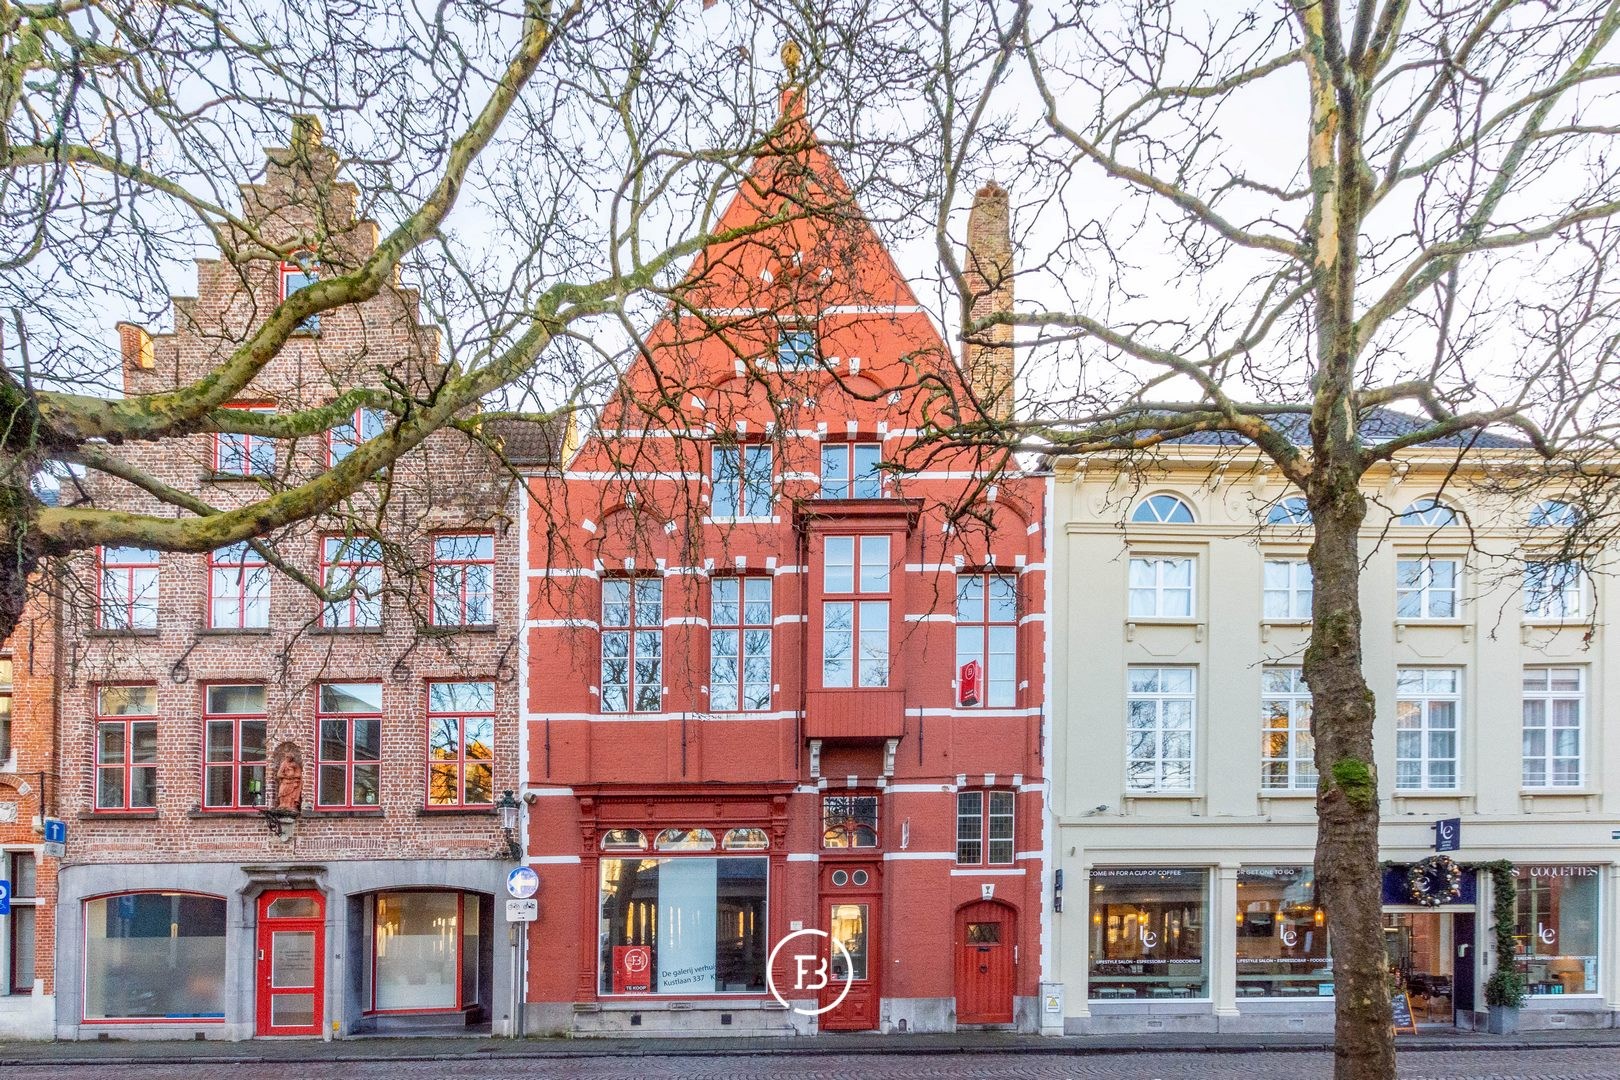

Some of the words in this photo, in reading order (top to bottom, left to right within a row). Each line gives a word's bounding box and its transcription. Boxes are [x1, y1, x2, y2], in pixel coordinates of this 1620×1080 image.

[1530, 866, 1598, 878] COQUETTES
[662, 970, 672, 978] De
[672, 966, 694, 977] galerij
[663, 977, 692, 986] Kustlaan
[693, 974, 705, 983] 337
